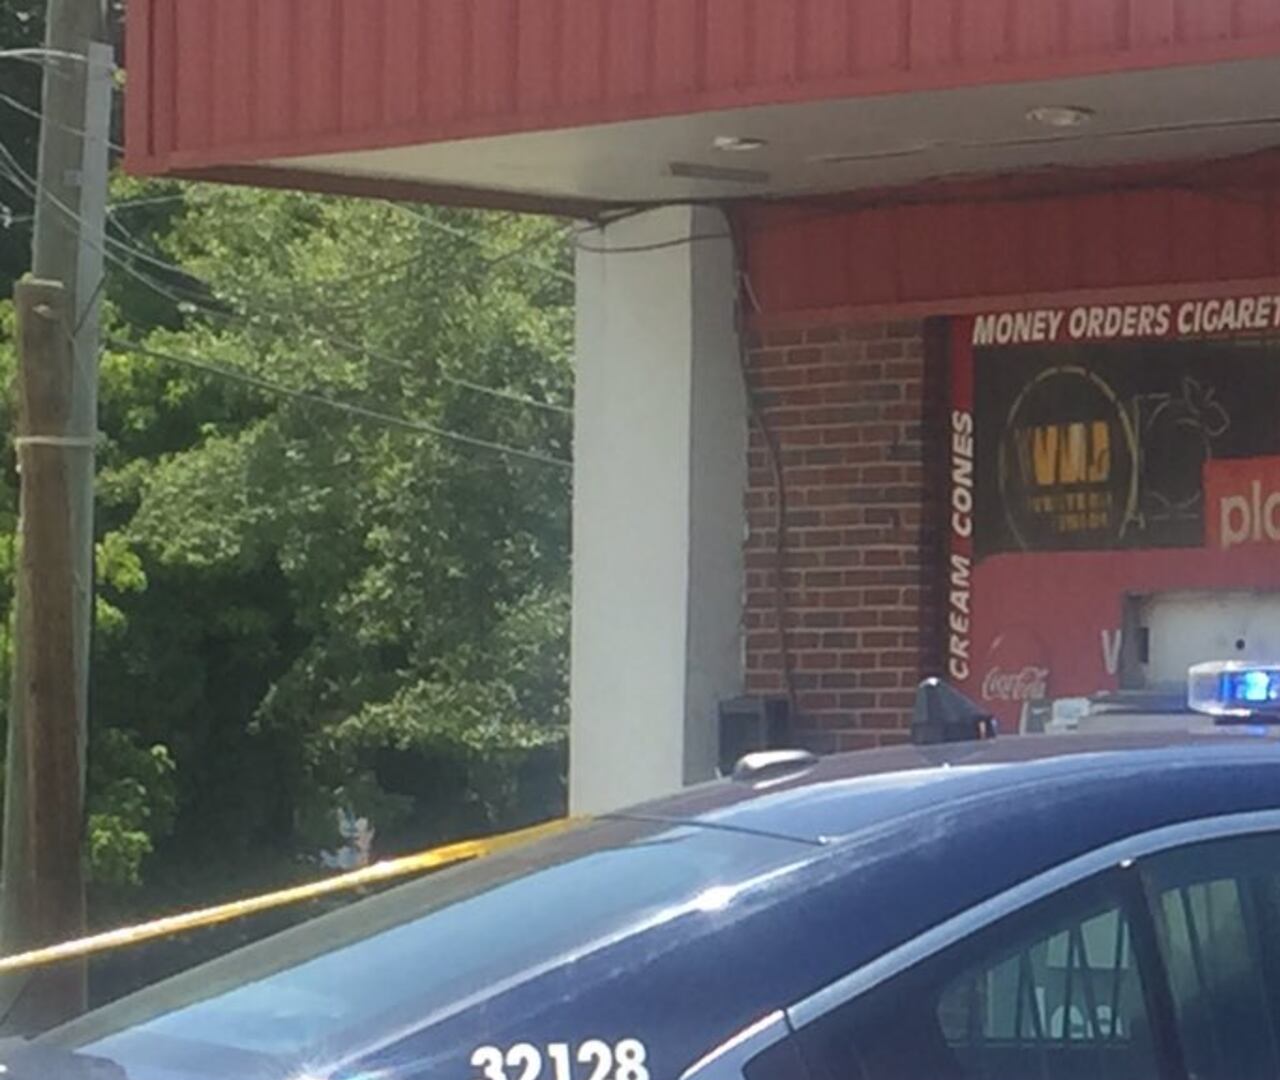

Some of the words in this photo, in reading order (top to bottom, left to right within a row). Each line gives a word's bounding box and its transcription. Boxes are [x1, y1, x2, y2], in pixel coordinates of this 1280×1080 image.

[972, 310, 1064, 346] MONEY
[1067, 302, 1170, 340] ORDERS
[951, 410, 974, 537] CONES
[949, 553, 971, 681] CREAM
